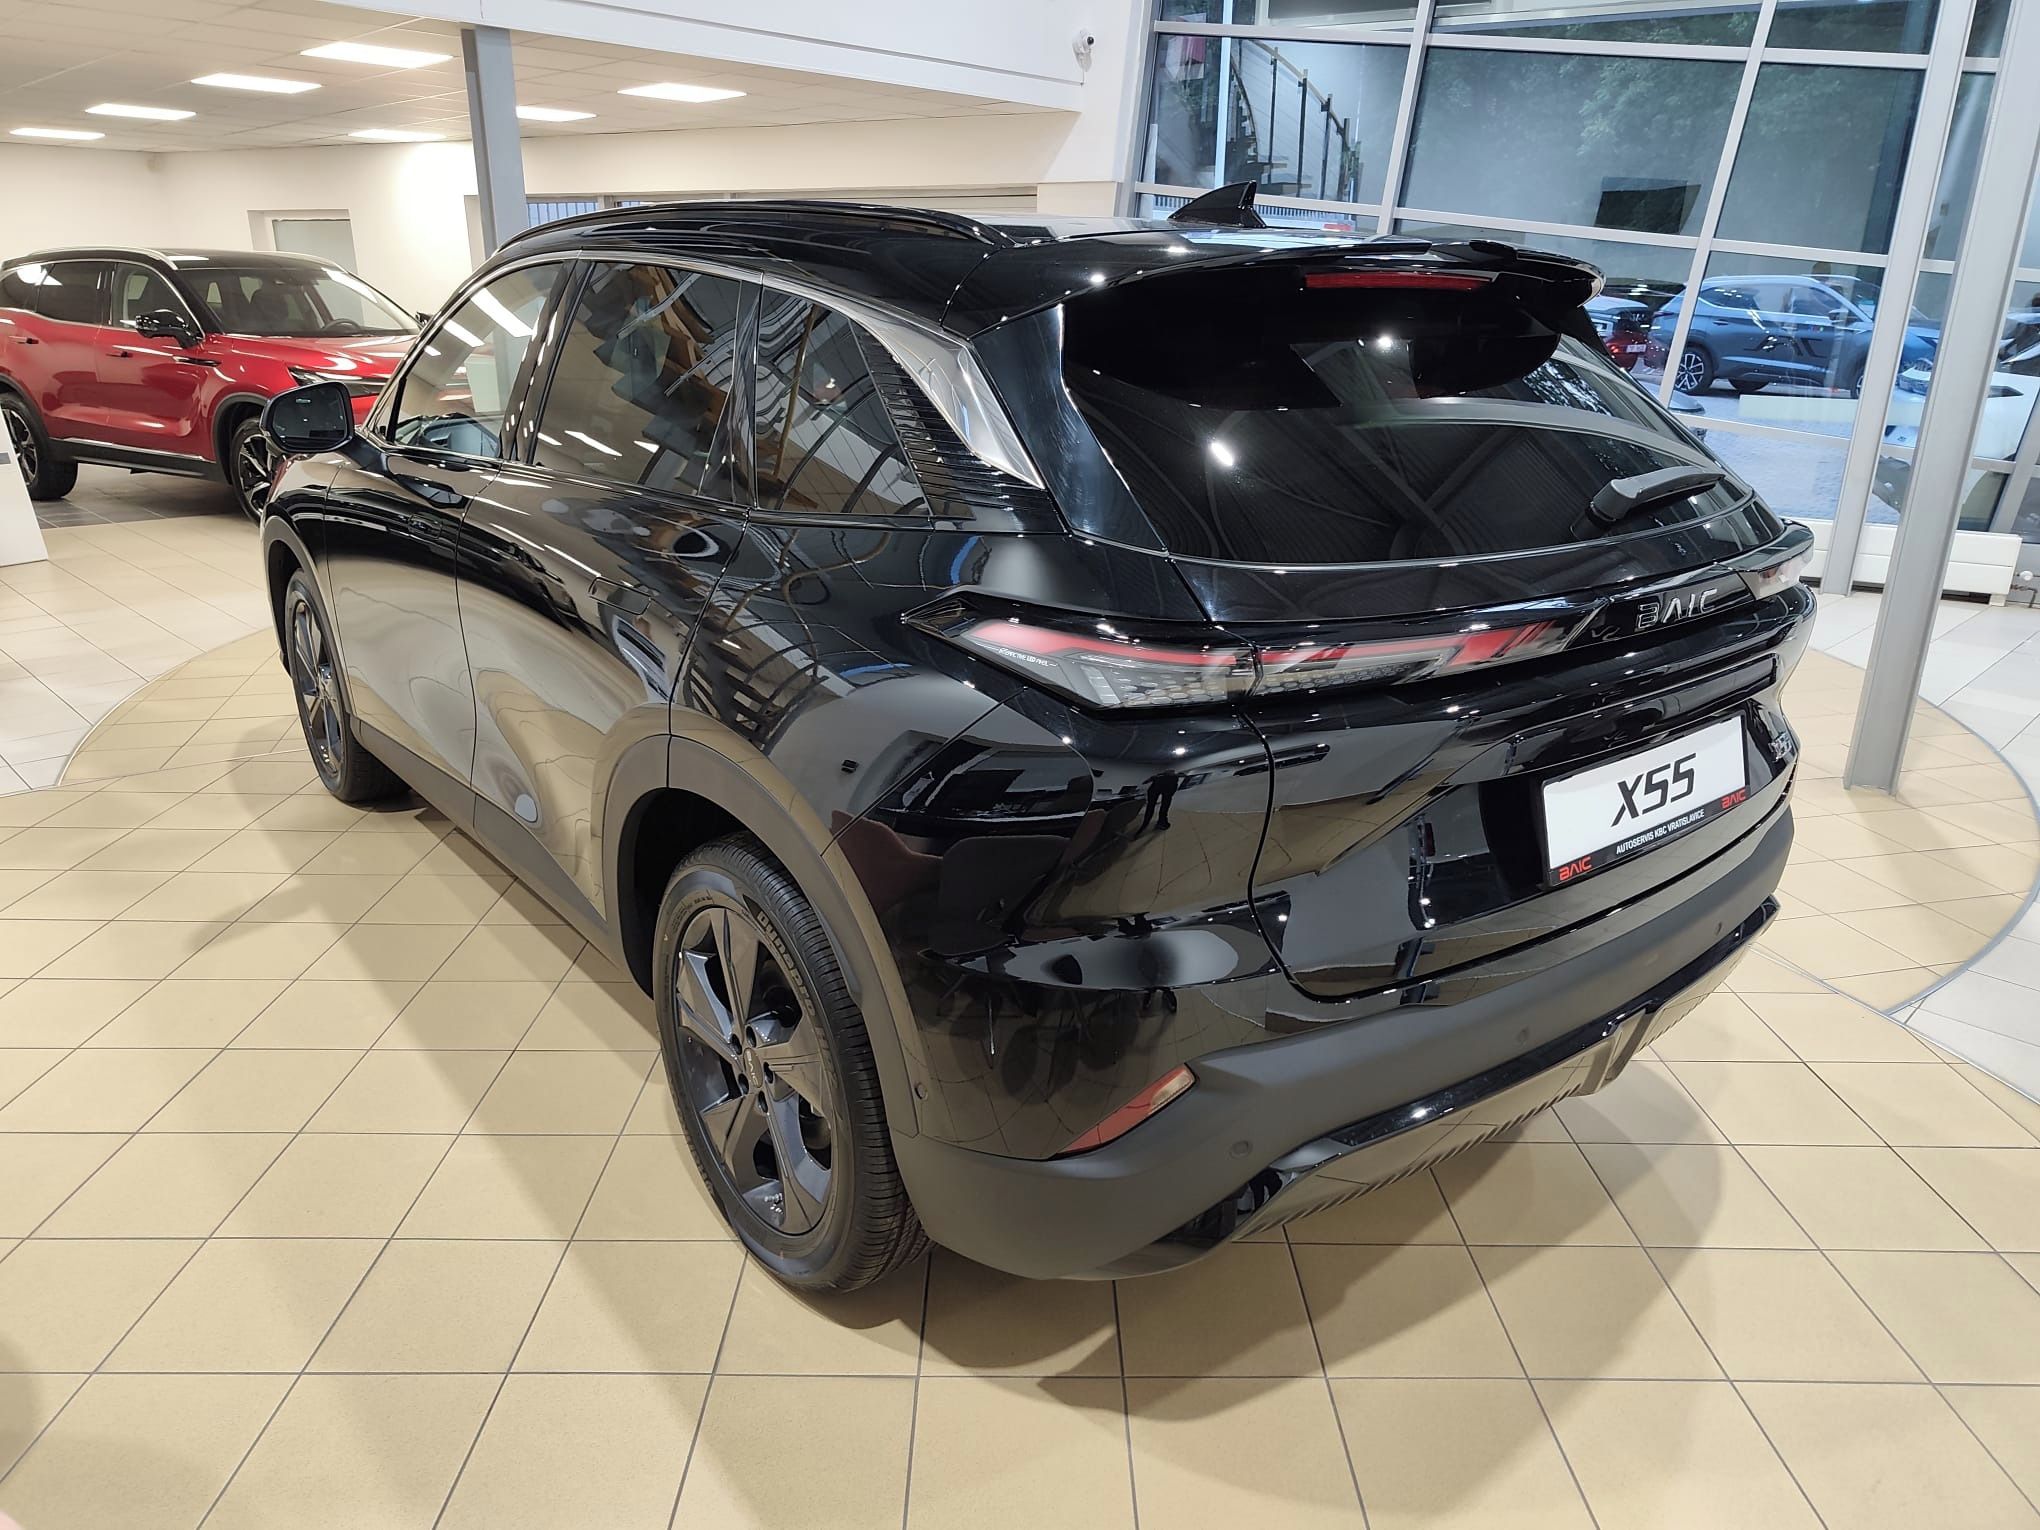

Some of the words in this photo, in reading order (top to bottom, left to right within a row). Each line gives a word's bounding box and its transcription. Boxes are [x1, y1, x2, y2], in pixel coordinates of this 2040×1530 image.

[1637, 588, 1718, 629] BAIC
[1610, 752, 1697, 827] X55
[1720, 789, 1747, 809] BAIC
[1616, 831, 1655, 855] AUTOSERVIS
[1654, 826, 1667, 839] KBC
[1667, 809, 1705, 832] VRATISLAVICE
[1558, 856, 1593, 881] BAIC
